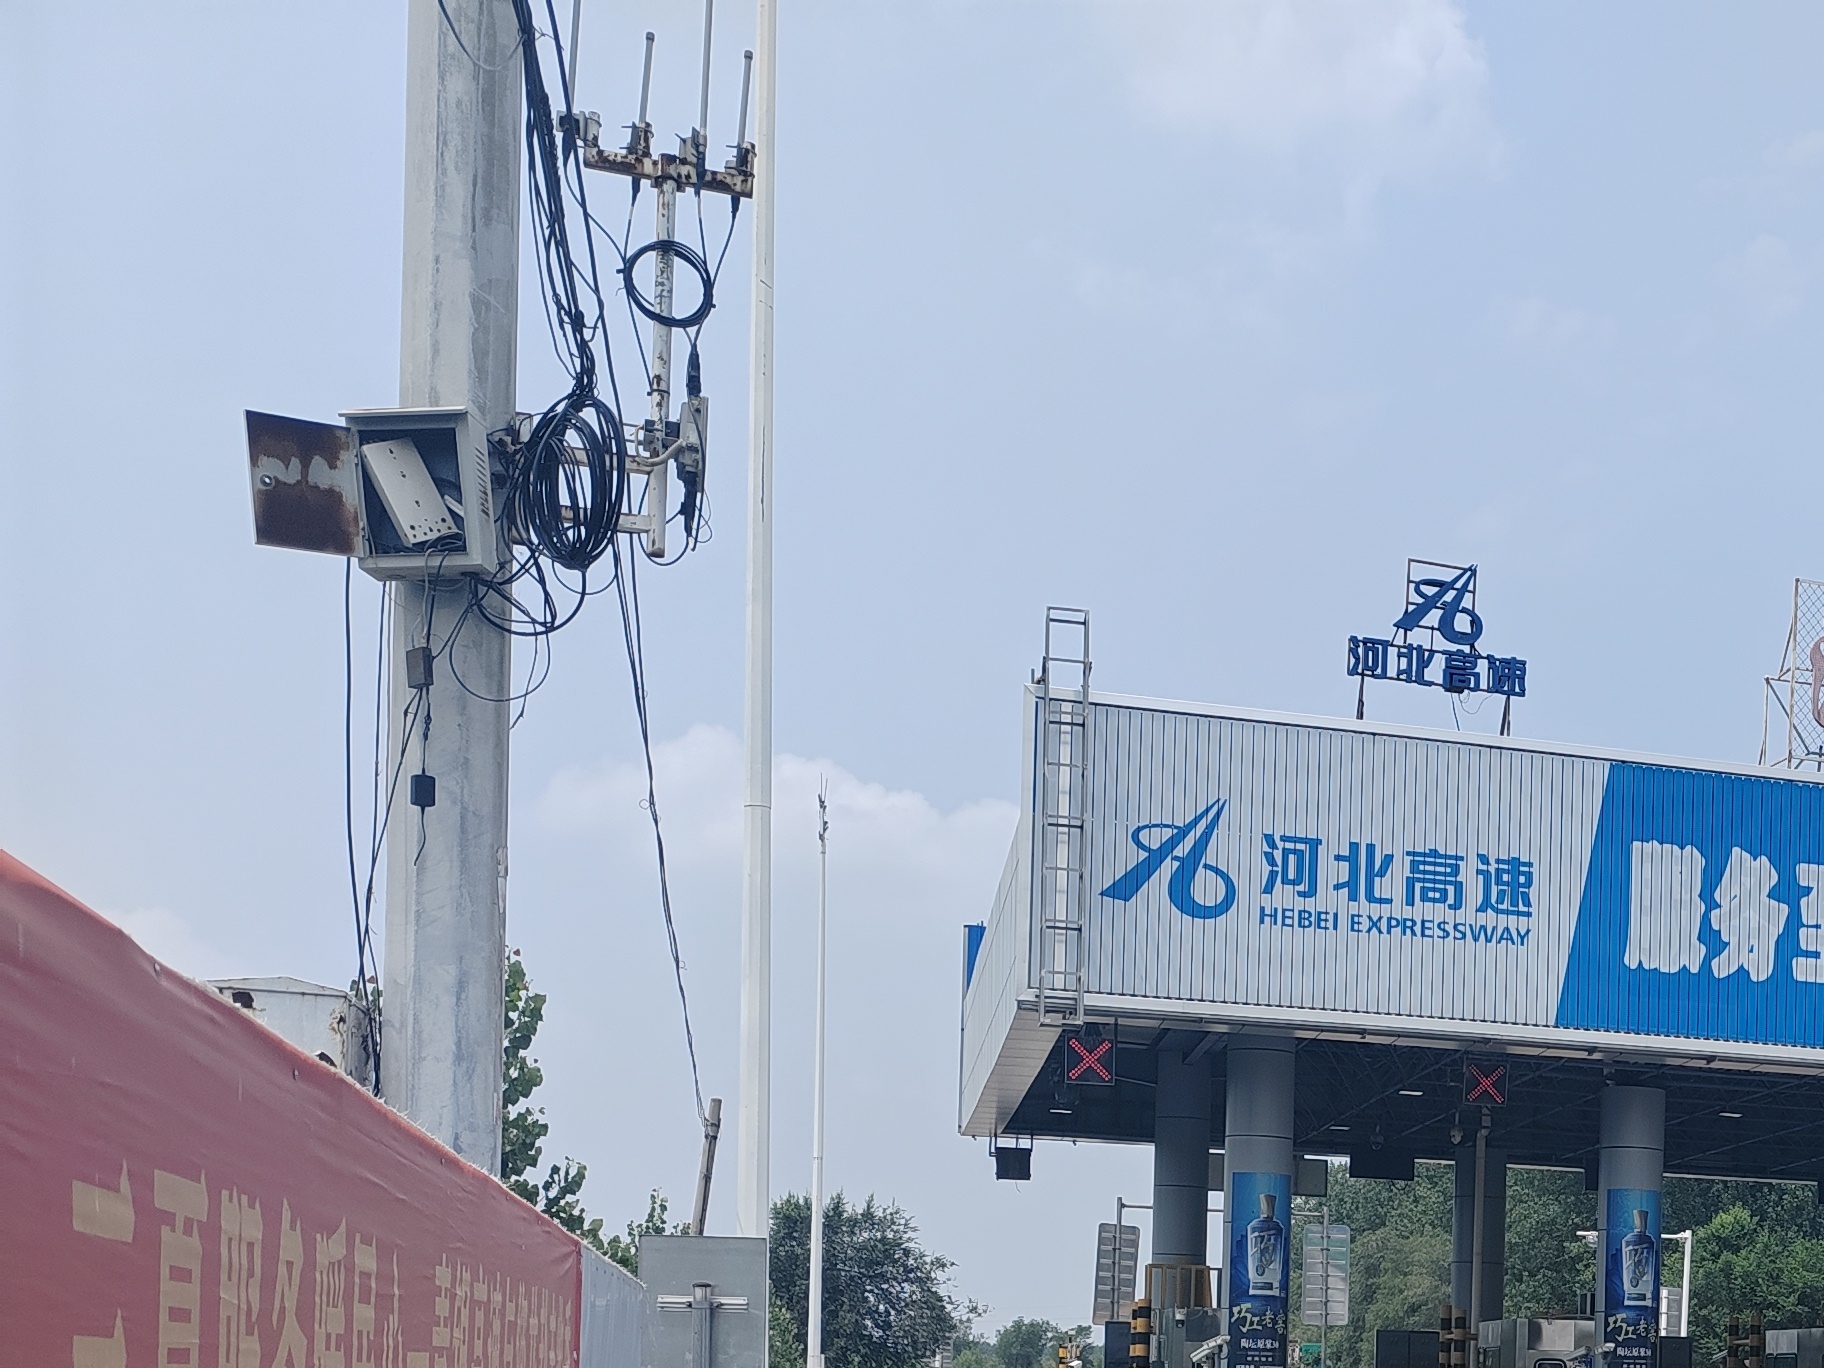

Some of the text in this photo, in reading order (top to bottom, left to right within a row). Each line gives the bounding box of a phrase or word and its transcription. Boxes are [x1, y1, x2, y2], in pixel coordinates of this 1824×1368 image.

[1349, 635, 1527, 697] 河北高速
[1261, 832, 1534, 918] 河北高速
[1259, 905, 1532, 947] HEBEI EXPRESSWAY
